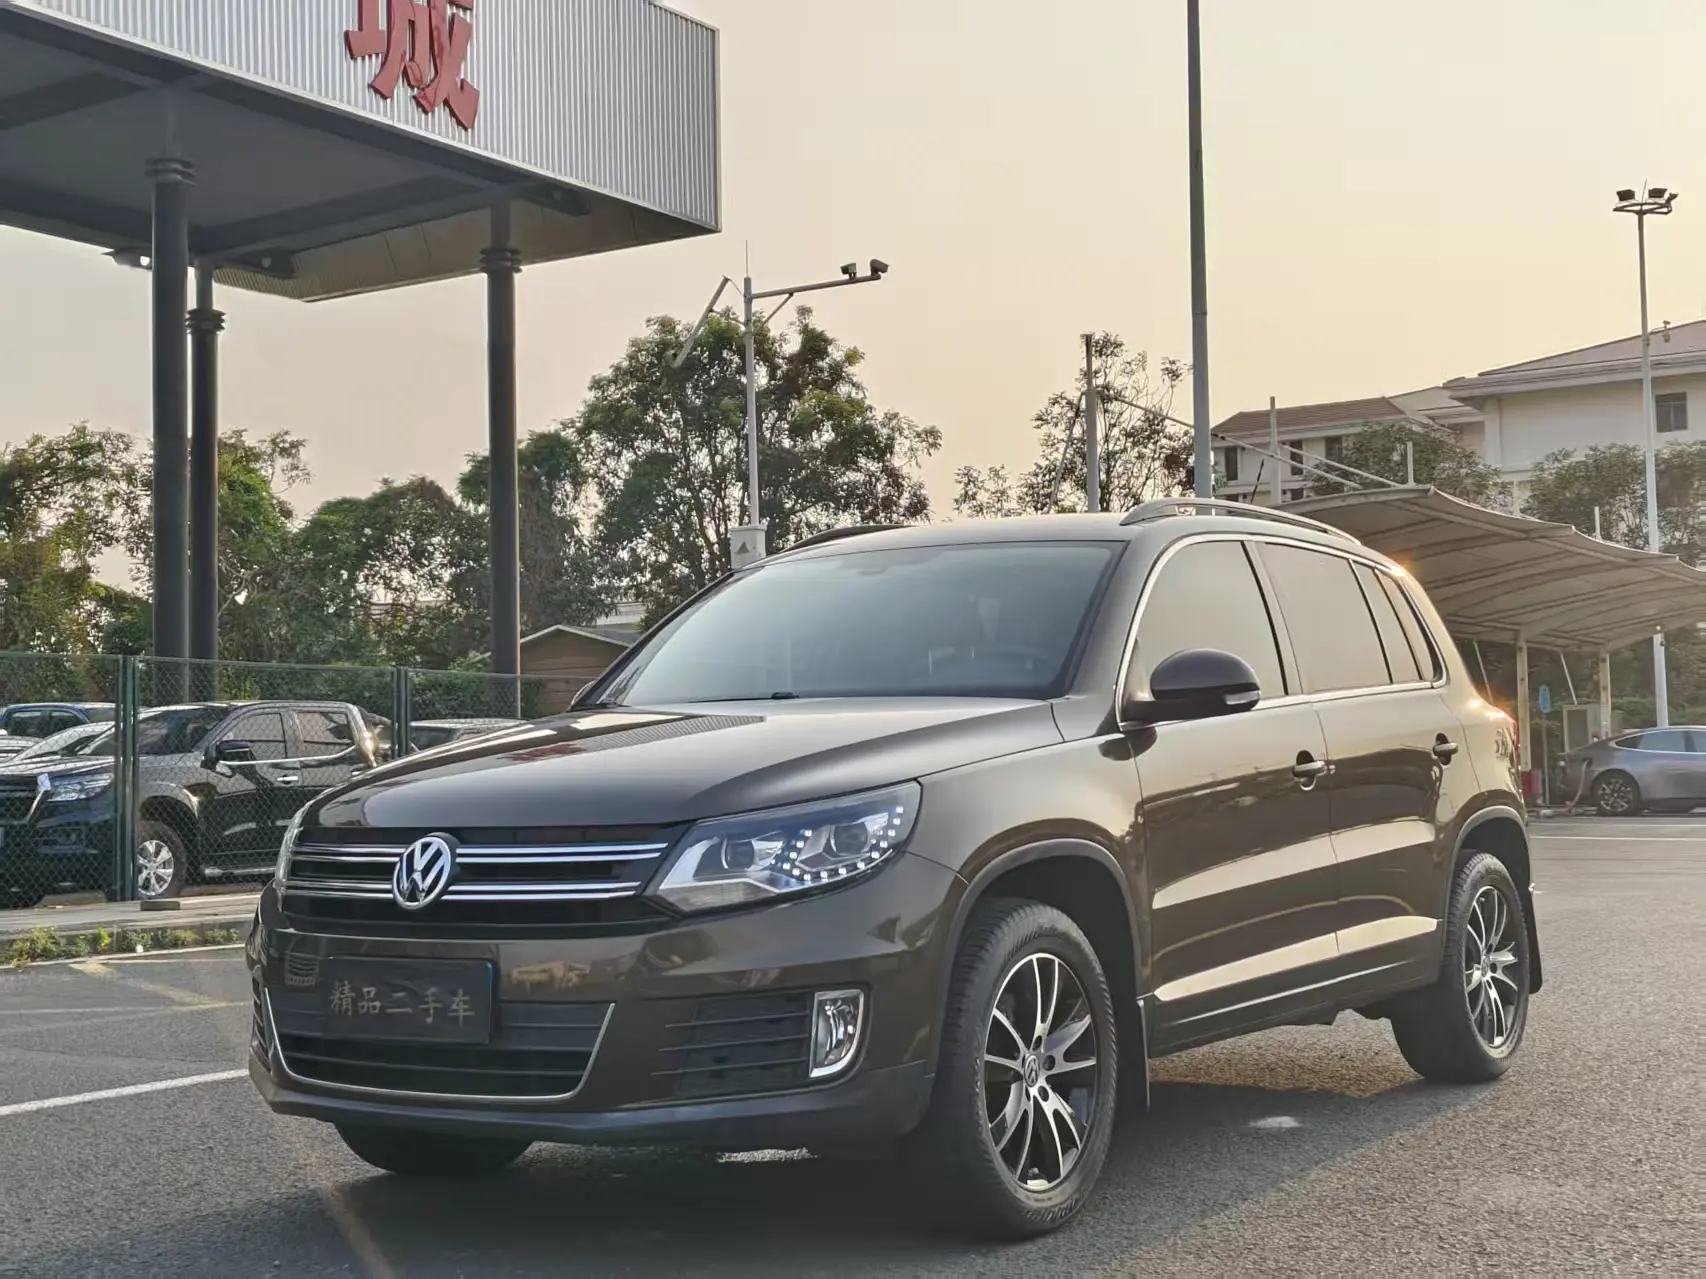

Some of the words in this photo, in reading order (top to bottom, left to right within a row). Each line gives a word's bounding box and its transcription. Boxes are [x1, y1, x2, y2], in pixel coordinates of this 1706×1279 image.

[330, 980, 475, 1027] 精品二手车
